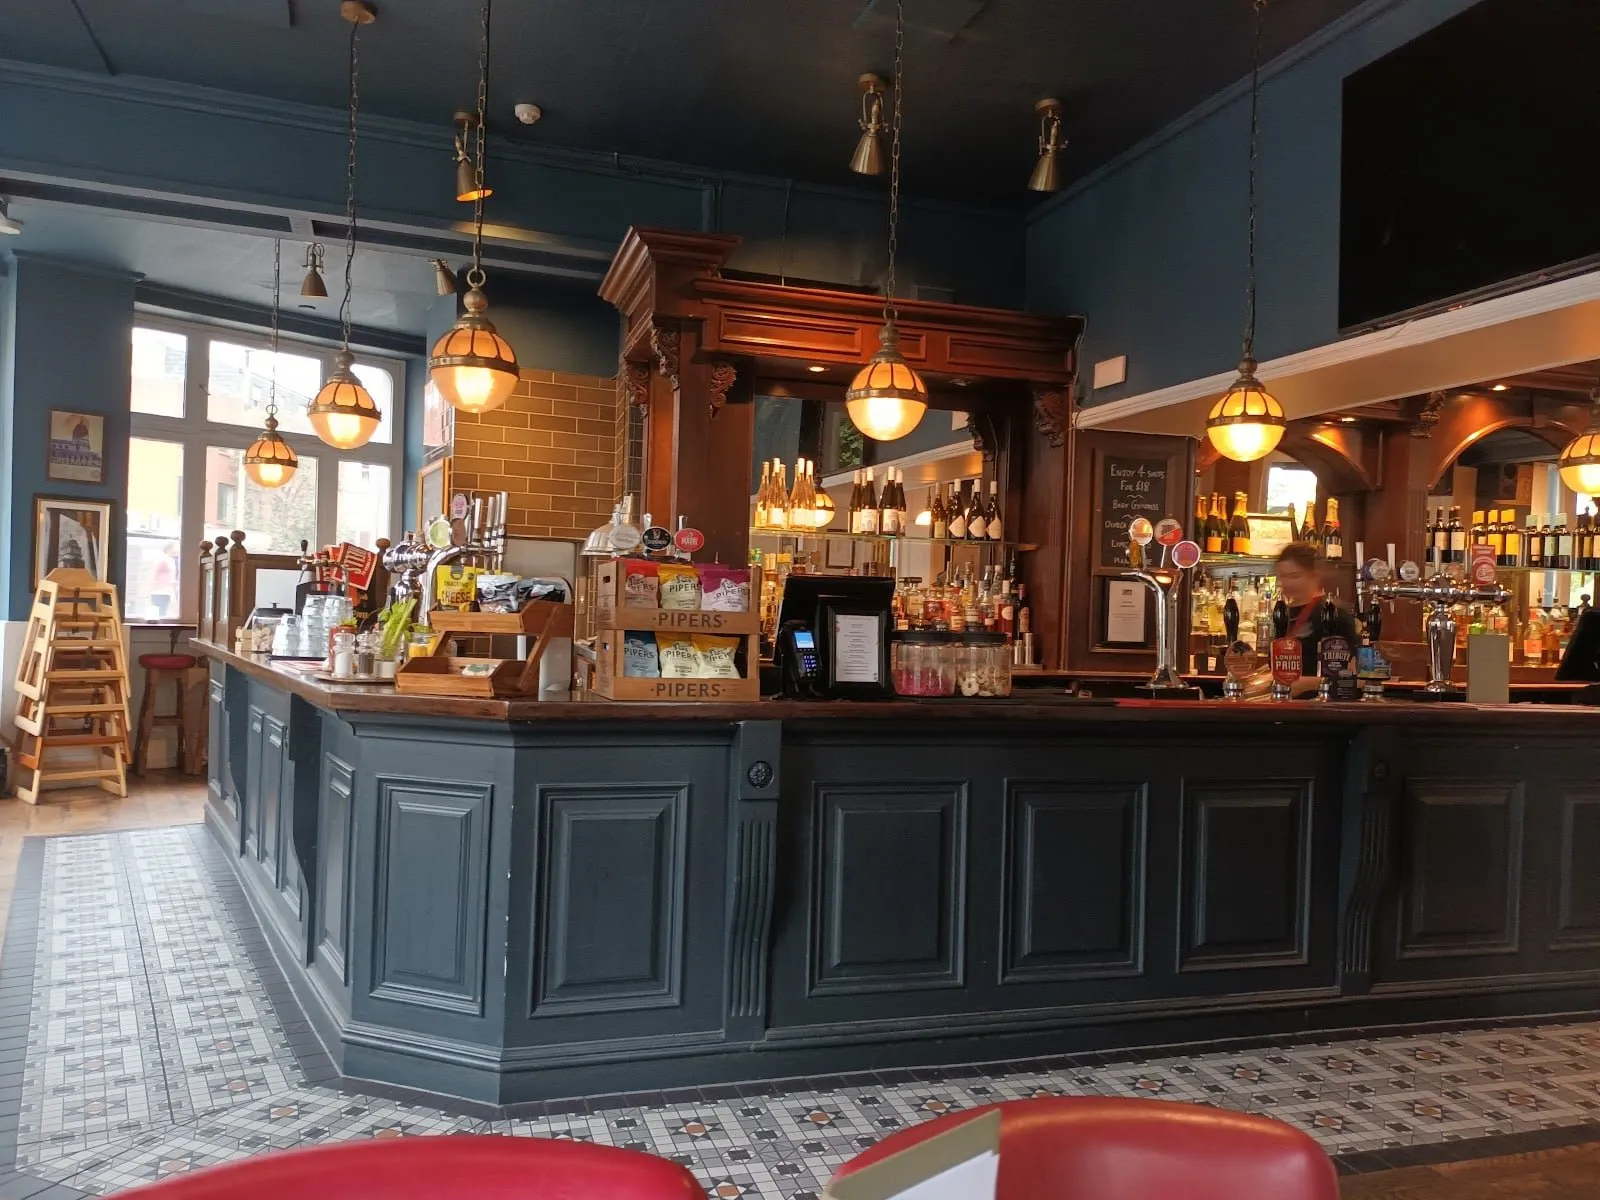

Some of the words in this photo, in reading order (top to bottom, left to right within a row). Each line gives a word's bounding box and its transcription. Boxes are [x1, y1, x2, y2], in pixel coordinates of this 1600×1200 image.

[1137, 464, 1146, 478] 4
[658, 612, 723, 628] PIPERS
[624, 647, 654, 659] PIPERS
[666, 650, 697, 661] PIPERS
[1275, 660, 1301, 671] PRIDE
[656, 683, 721, 697] PIPERS
